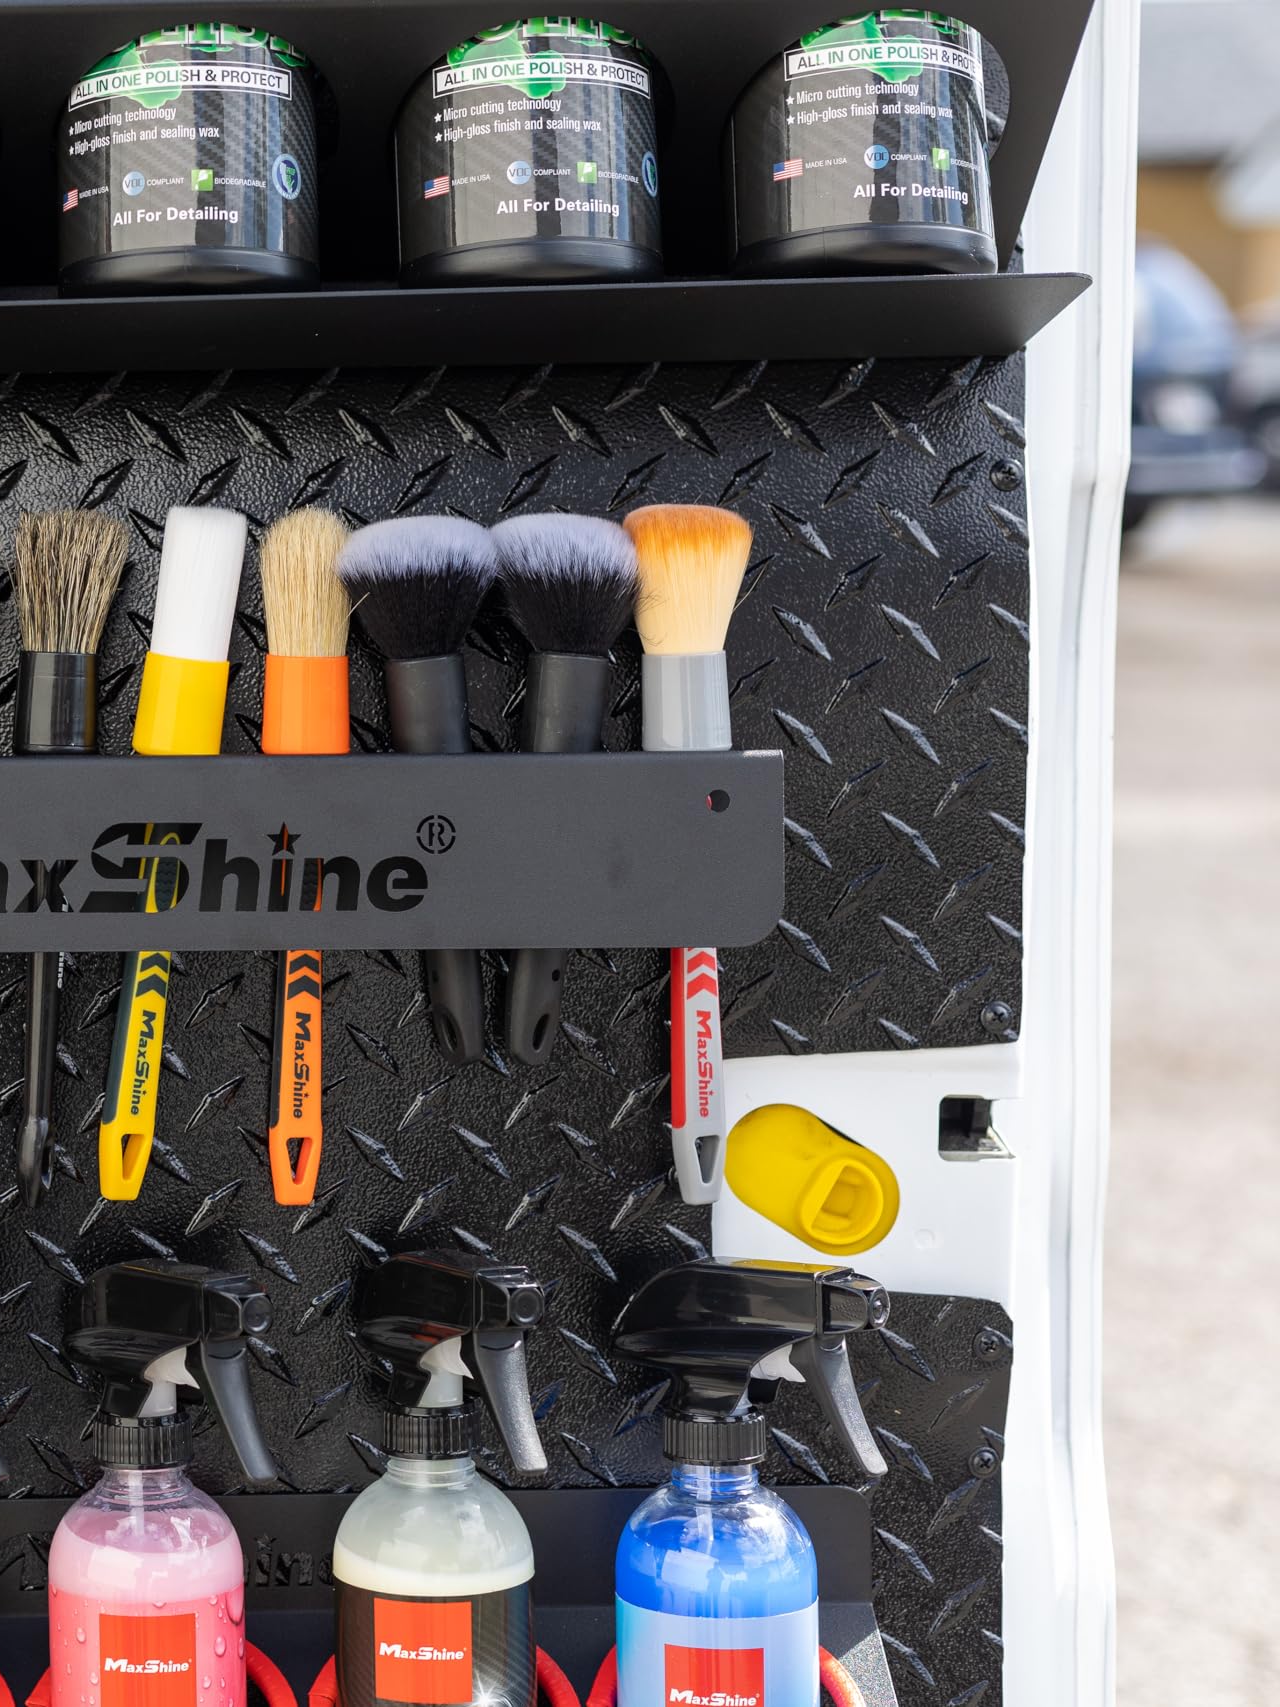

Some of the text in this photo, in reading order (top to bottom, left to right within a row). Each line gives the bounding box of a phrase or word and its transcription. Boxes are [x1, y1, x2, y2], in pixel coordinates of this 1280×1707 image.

[797, 55, 824, 70] ALL
[828, 50, 844, 64] IN
[848, 47, 882, 61] ONE
[887, 46, 938, 61] POLISH
[942, 50, 950, 64] &
[75, 69, 282, 99] ALL IN ONE POLISH & PROTECT
[444, 62, 645, 87] ALL IN ONE POLISH & PROTECT
[796, 81, 919, 104] Micro cutting technology
[74, 107, 177, 135] Micro cutting technology
[443, 97, 562, 122] Micro cutting technology
[797, 101, 953, 125] High-gloss finish and sealing wax
[74, 125, 220, 155] High-gloss finish and sealing wax
[443, 117, 601, 142] High-gloss finish and sealing wax
[833, 157, 847, 166] USA
[891, 153, 927, 161] COMPLIANT
[146, 178, 184, 186] COMPLIANT
[477, 173, 491, 182] USA
[97, 186, 109, 196] USA
[853, 183, 968, 205] All For Detailing
[113, 207, 239, 226] All For Detailing
[497, 198, 620, 217] All For Detailing
[130, 1010, 157, 1115] MaxShine
[293, 1011, 312, 1119] MaxShine
[696, 1010, 713, 1117] MaxShine
